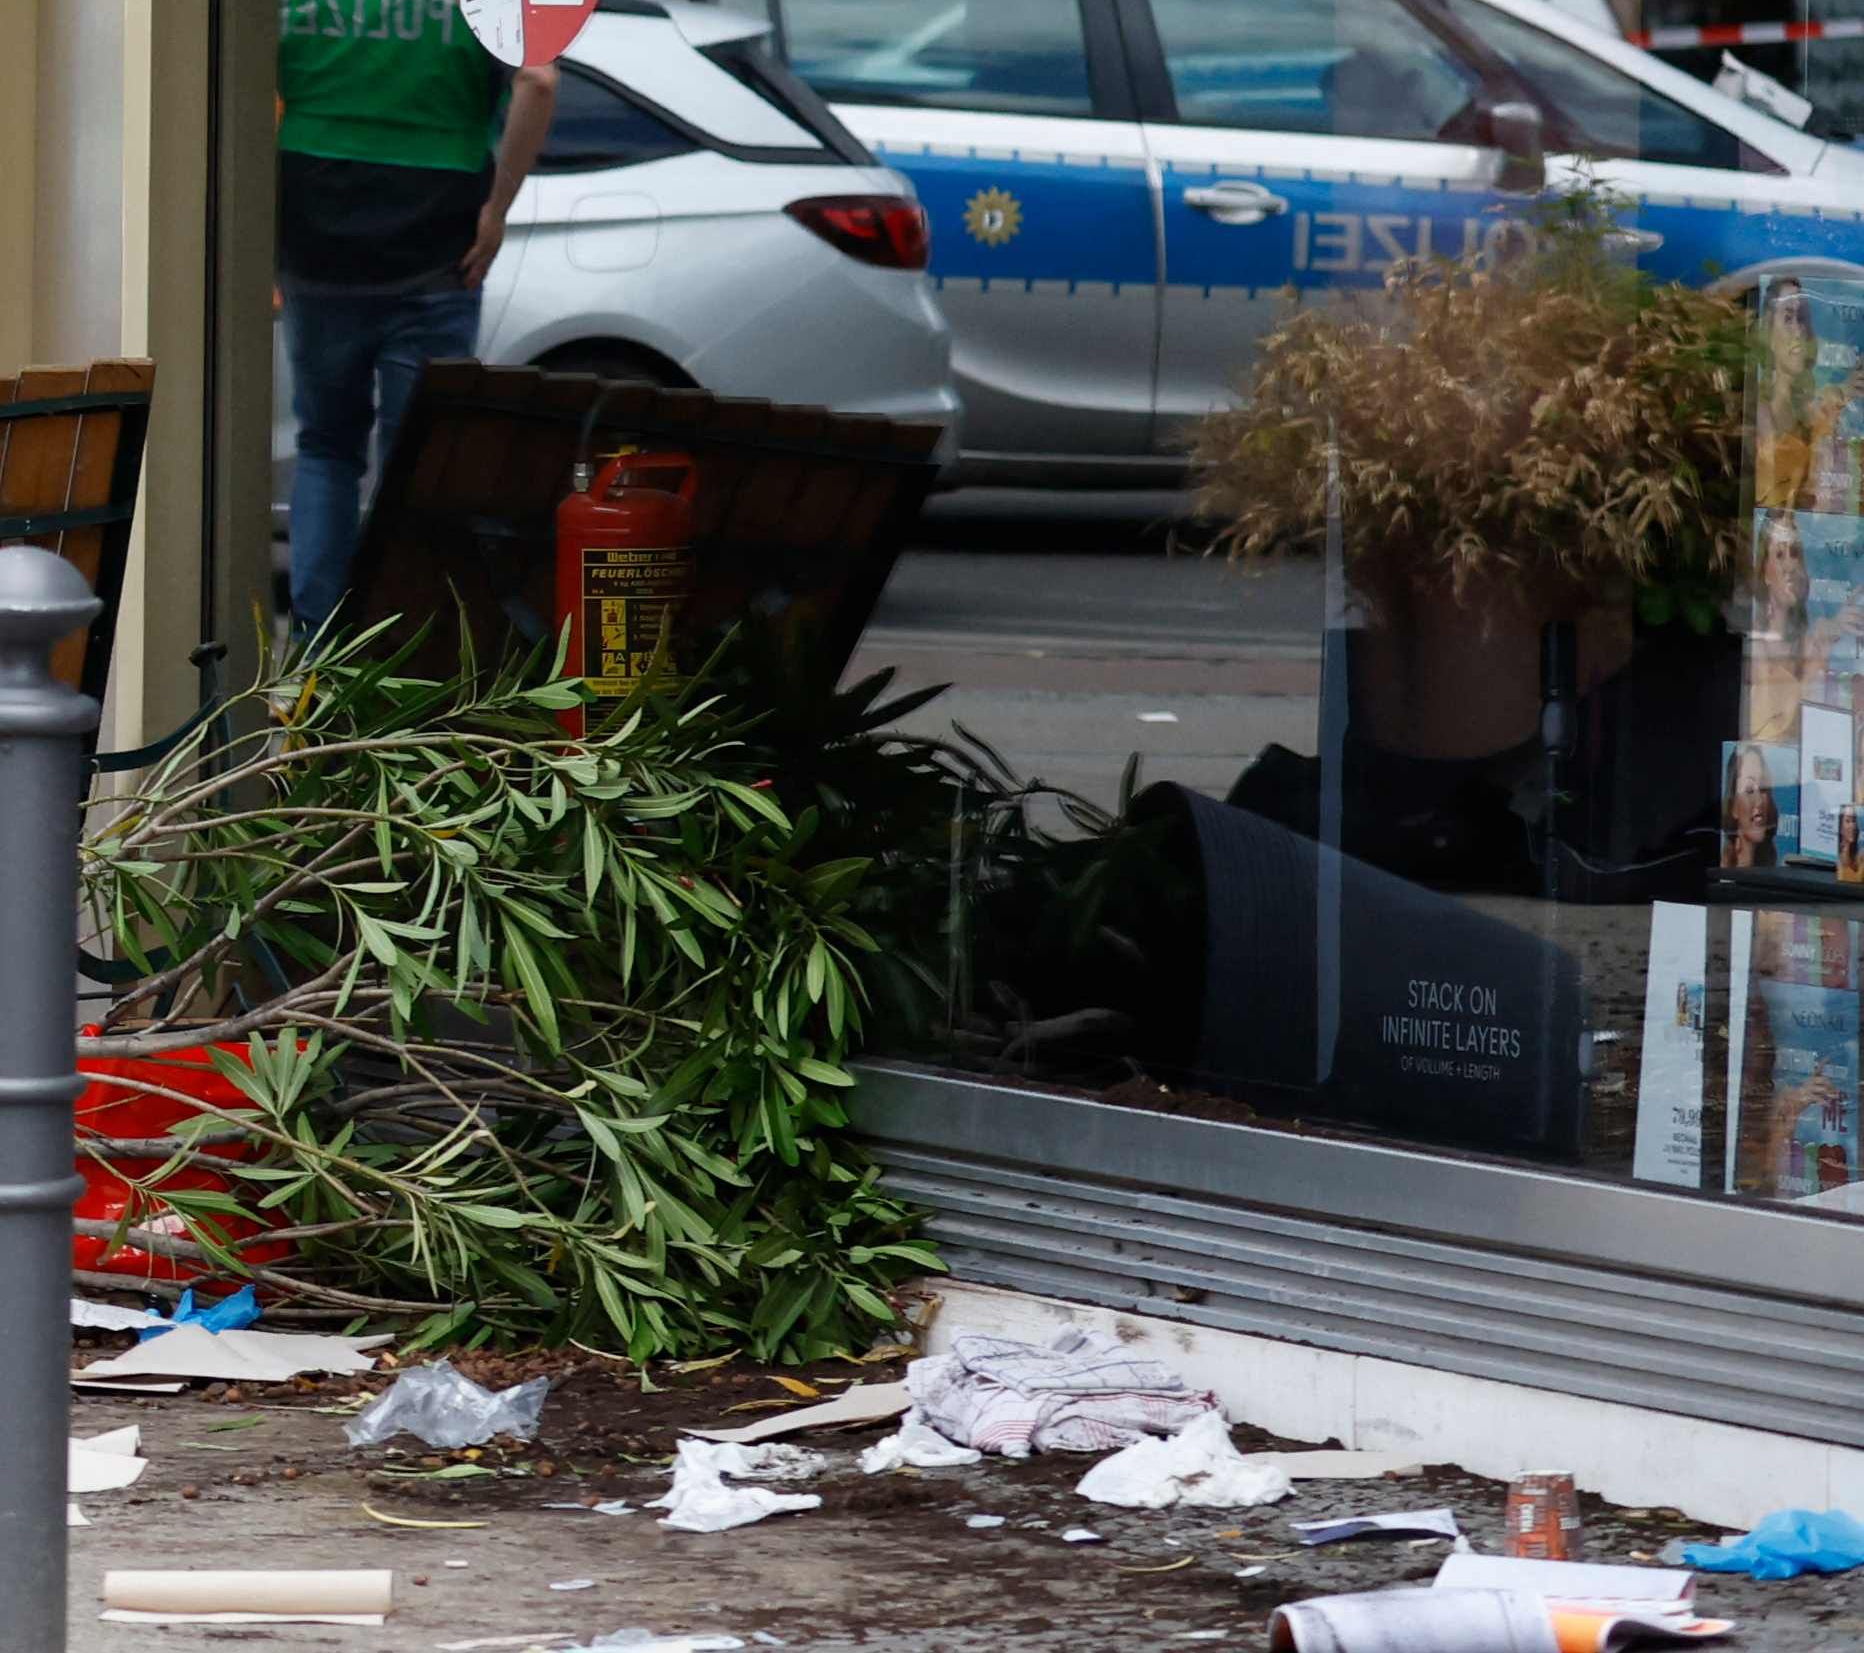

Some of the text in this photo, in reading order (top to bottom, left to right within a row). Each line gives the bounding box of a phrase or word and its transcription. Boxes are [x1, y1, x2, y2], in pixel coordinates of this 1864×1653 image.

[1408, 979, 1497, 1016] STACK ON
[1382, 1015, 1521, 1058] INFINITE LAYERS
[1401, 1055, 1414, 1072] OF
[1416, 1057, 1454, 1076] VOLUME
[1464, 1062, 1500, 1081] LENGTH
